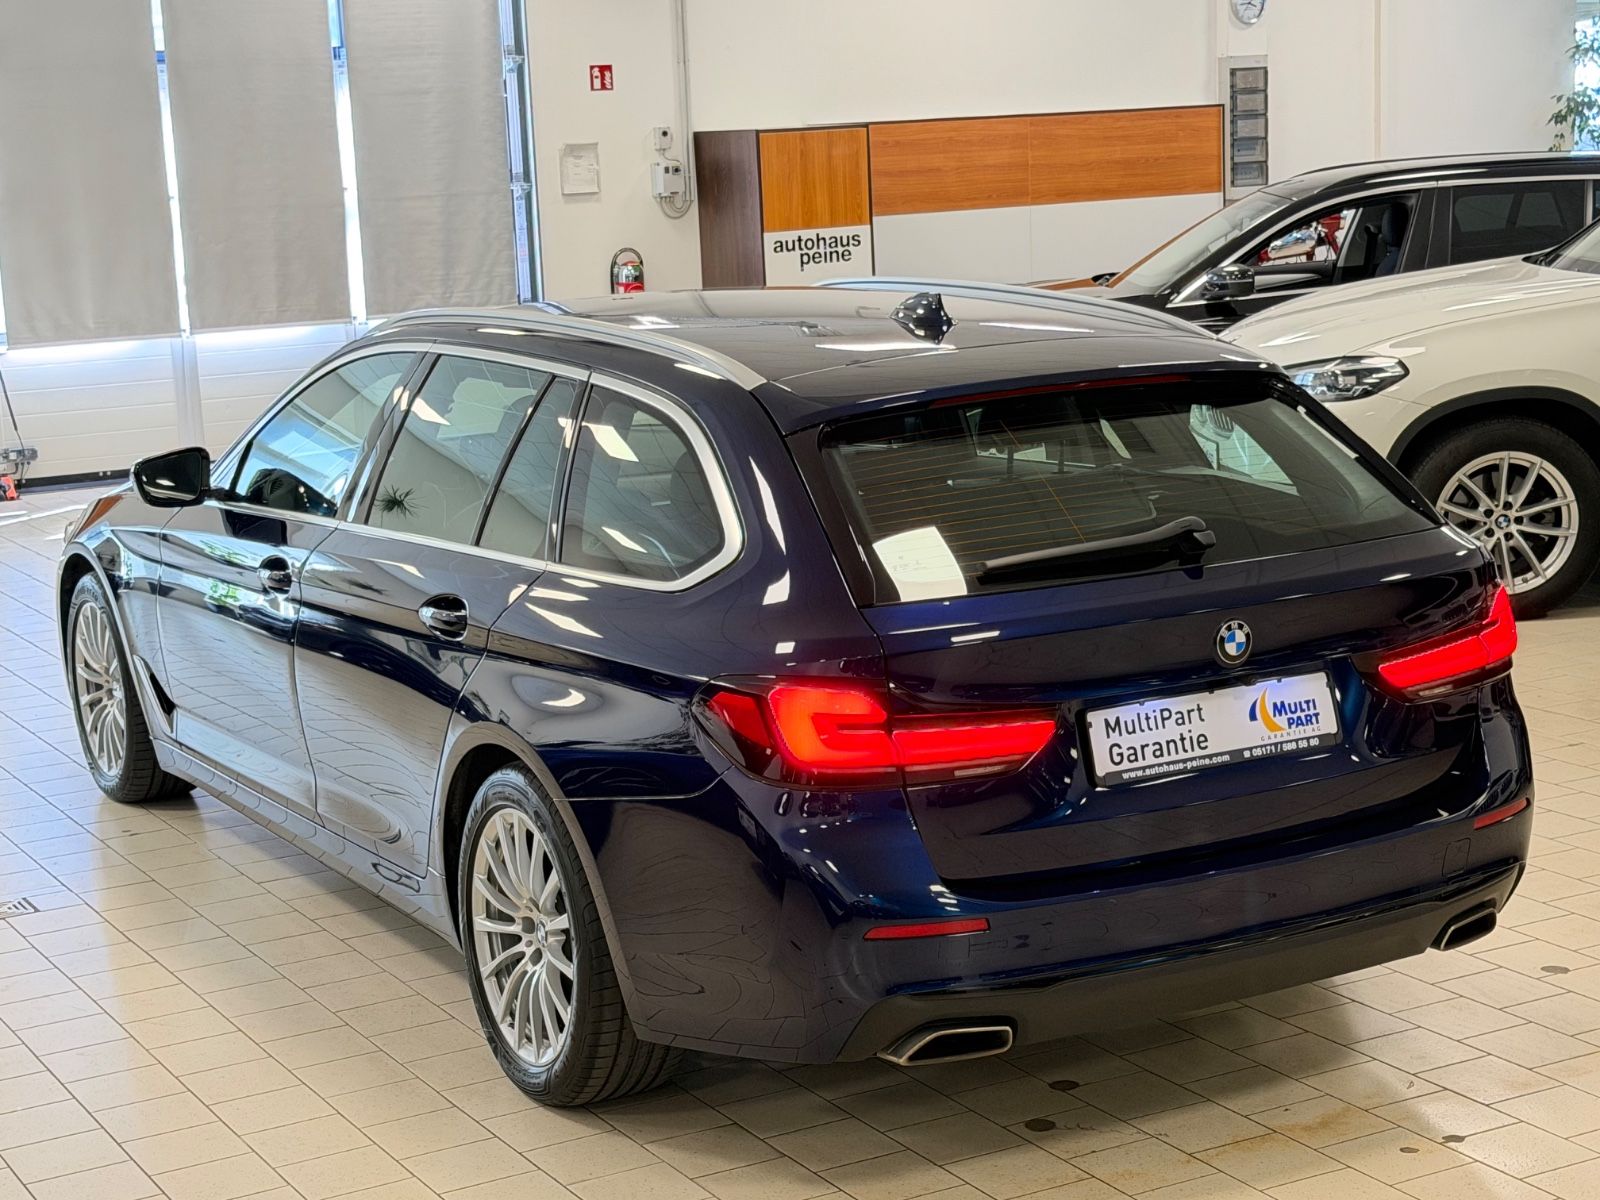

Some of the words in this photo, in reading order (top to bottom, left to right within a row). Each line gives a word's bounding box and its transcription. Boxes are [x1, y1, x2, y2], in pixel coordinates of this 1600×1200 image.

[773, 233, 861, 254] autohaus
[800, 247, 852, 272] peine
[1272, 698, 1317, 718] MULTI
[1103, 703, 1206, 739] MultiPart
[1287, 712, 1321, 730] PART
[1260, 730, 1307, 742] GARANTIE
[1311, 725, 1321, 733] AG
[1108, 729, 1209, 767] Garantie
[1252, 745, 1276, 757] 05171
[1298, 740, 1308, 748] 55
[1309, 737, 1319, 746] 80
[1122, 754, 1230, 780] www.autohaus-peine.com
